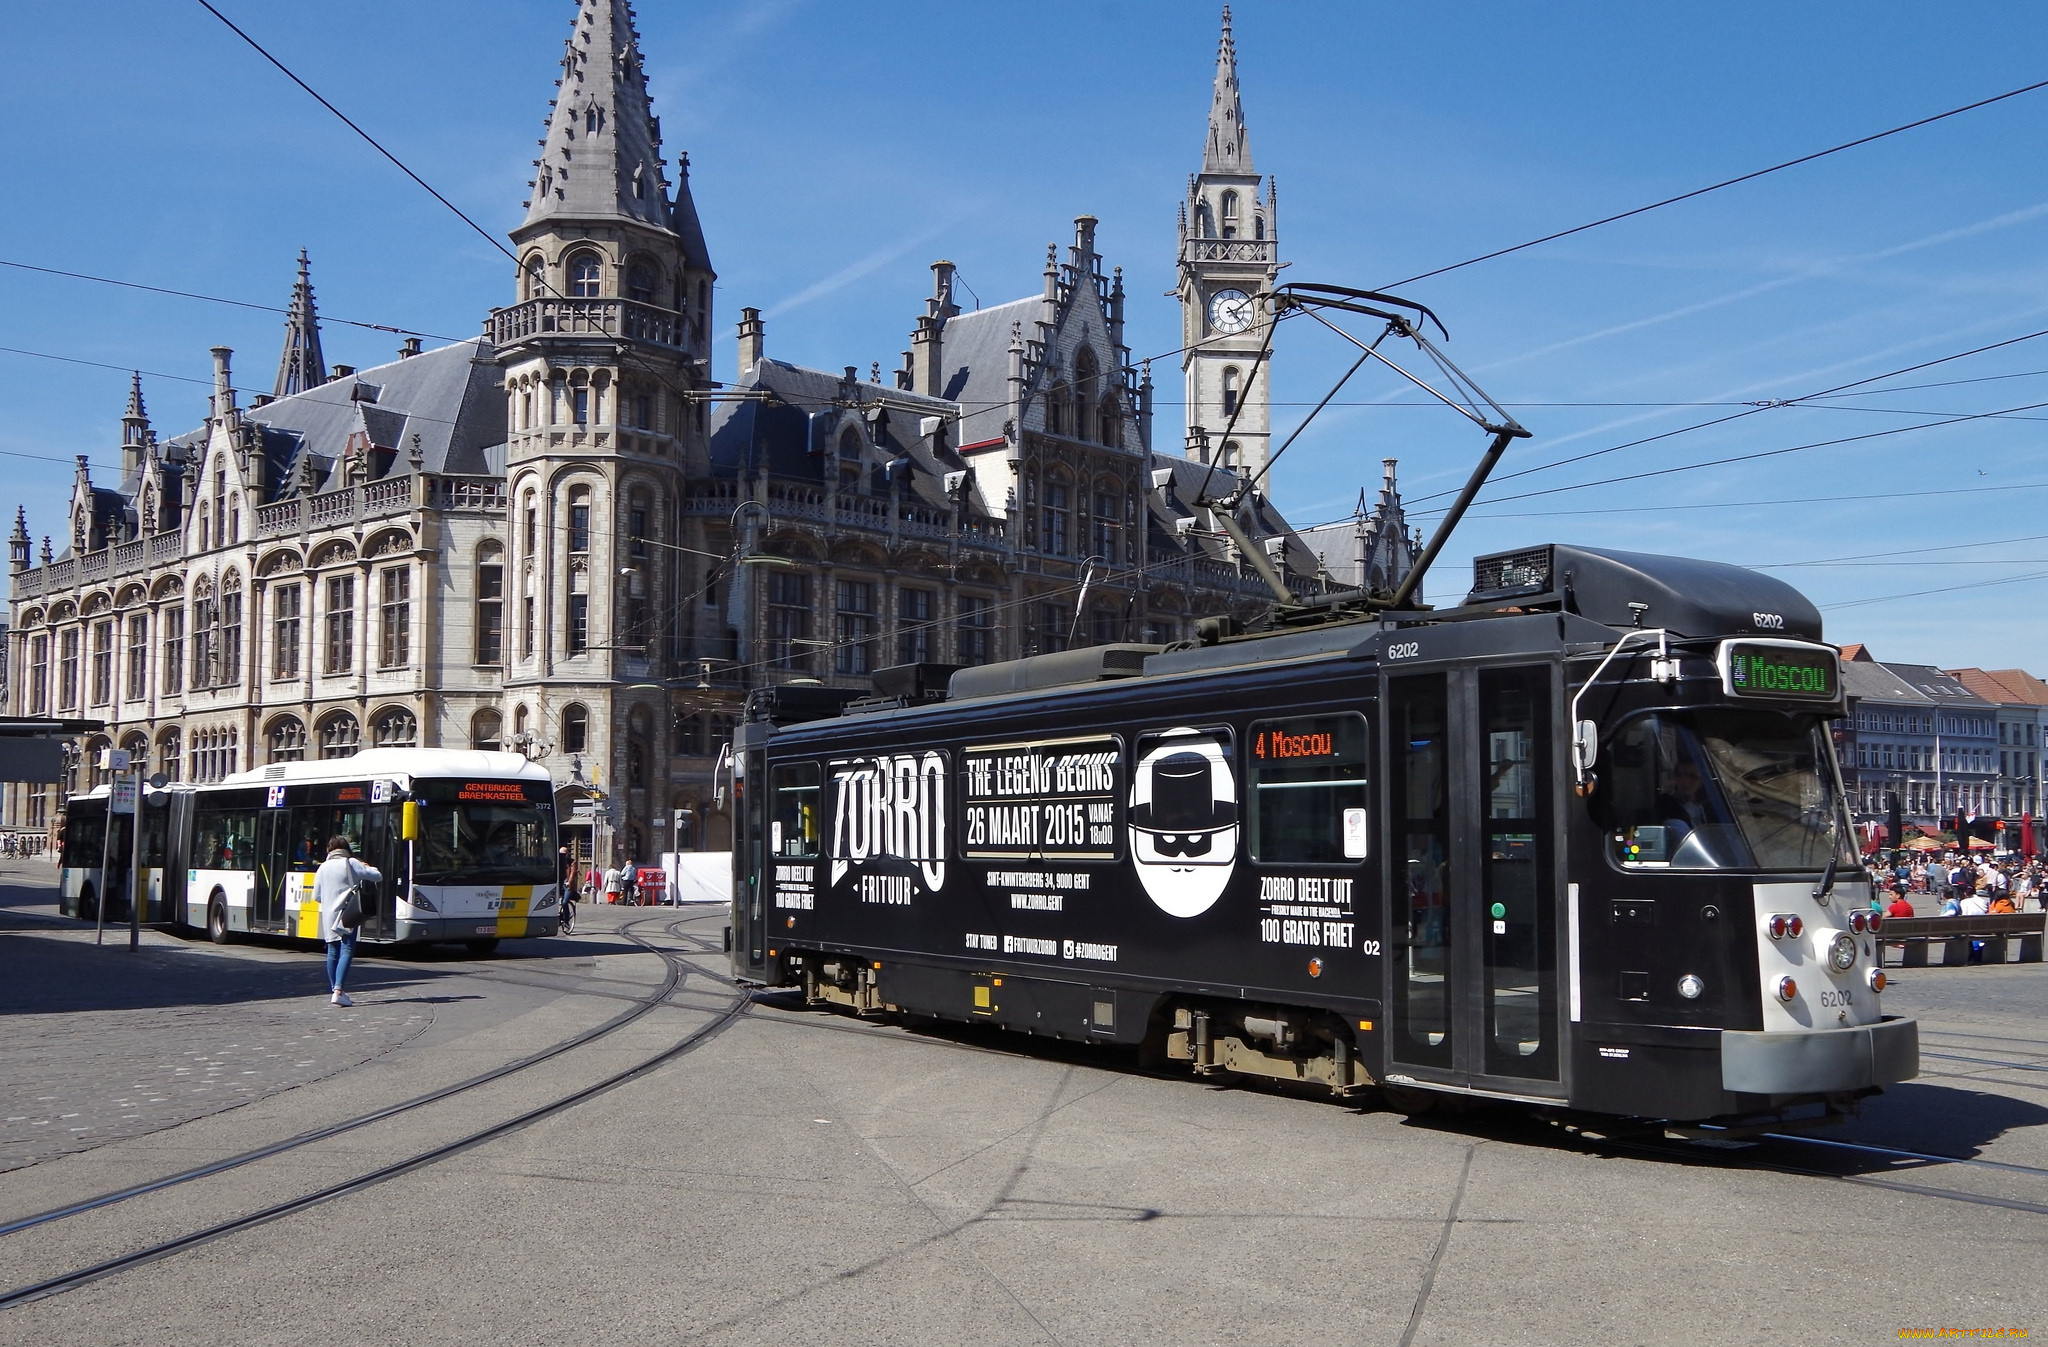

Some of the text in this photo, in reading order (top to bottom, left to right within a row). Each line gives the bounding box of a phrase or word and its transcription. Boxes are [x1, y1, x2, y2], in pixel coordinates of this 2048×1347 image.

[1753, 612, 1784, 629] 6202
[1388, 642, 1418, 659] 6202
[1751, 656, 1825, 692] Moscou
[1255, 731, 1331, 759] 4 Moscou
[115, 757, 122, 767] 2
[966, 752, 1118, 796] THE LEGEND BEGINS
[458, 792, 526, 801] BRAEMKASTEEL
[465, 783, 522, 792] GENTBRUGGE
[829, 750, 945, 892] ZORRO
[1088, 803, 1114, 823] VANAF
[967, 804, 1084, 845] 26 MAART 2015
[862, 875, 911, 905] FRITUUR
[1056, 873, 1073, 889] 9000
[1074, 873, 1090, 889] GENT
[1260, 877, 1353, 904] ZORRO DEELT UIT
[966, 933, 979, 949] STAY
[980, 934, 998, 950] TUNED
[1261, 918, 1354, 948] 100 GRATIS FRIET
[1363, 940, 1380, 956] 02
[1821, 990, 1853, 1007] 6202
